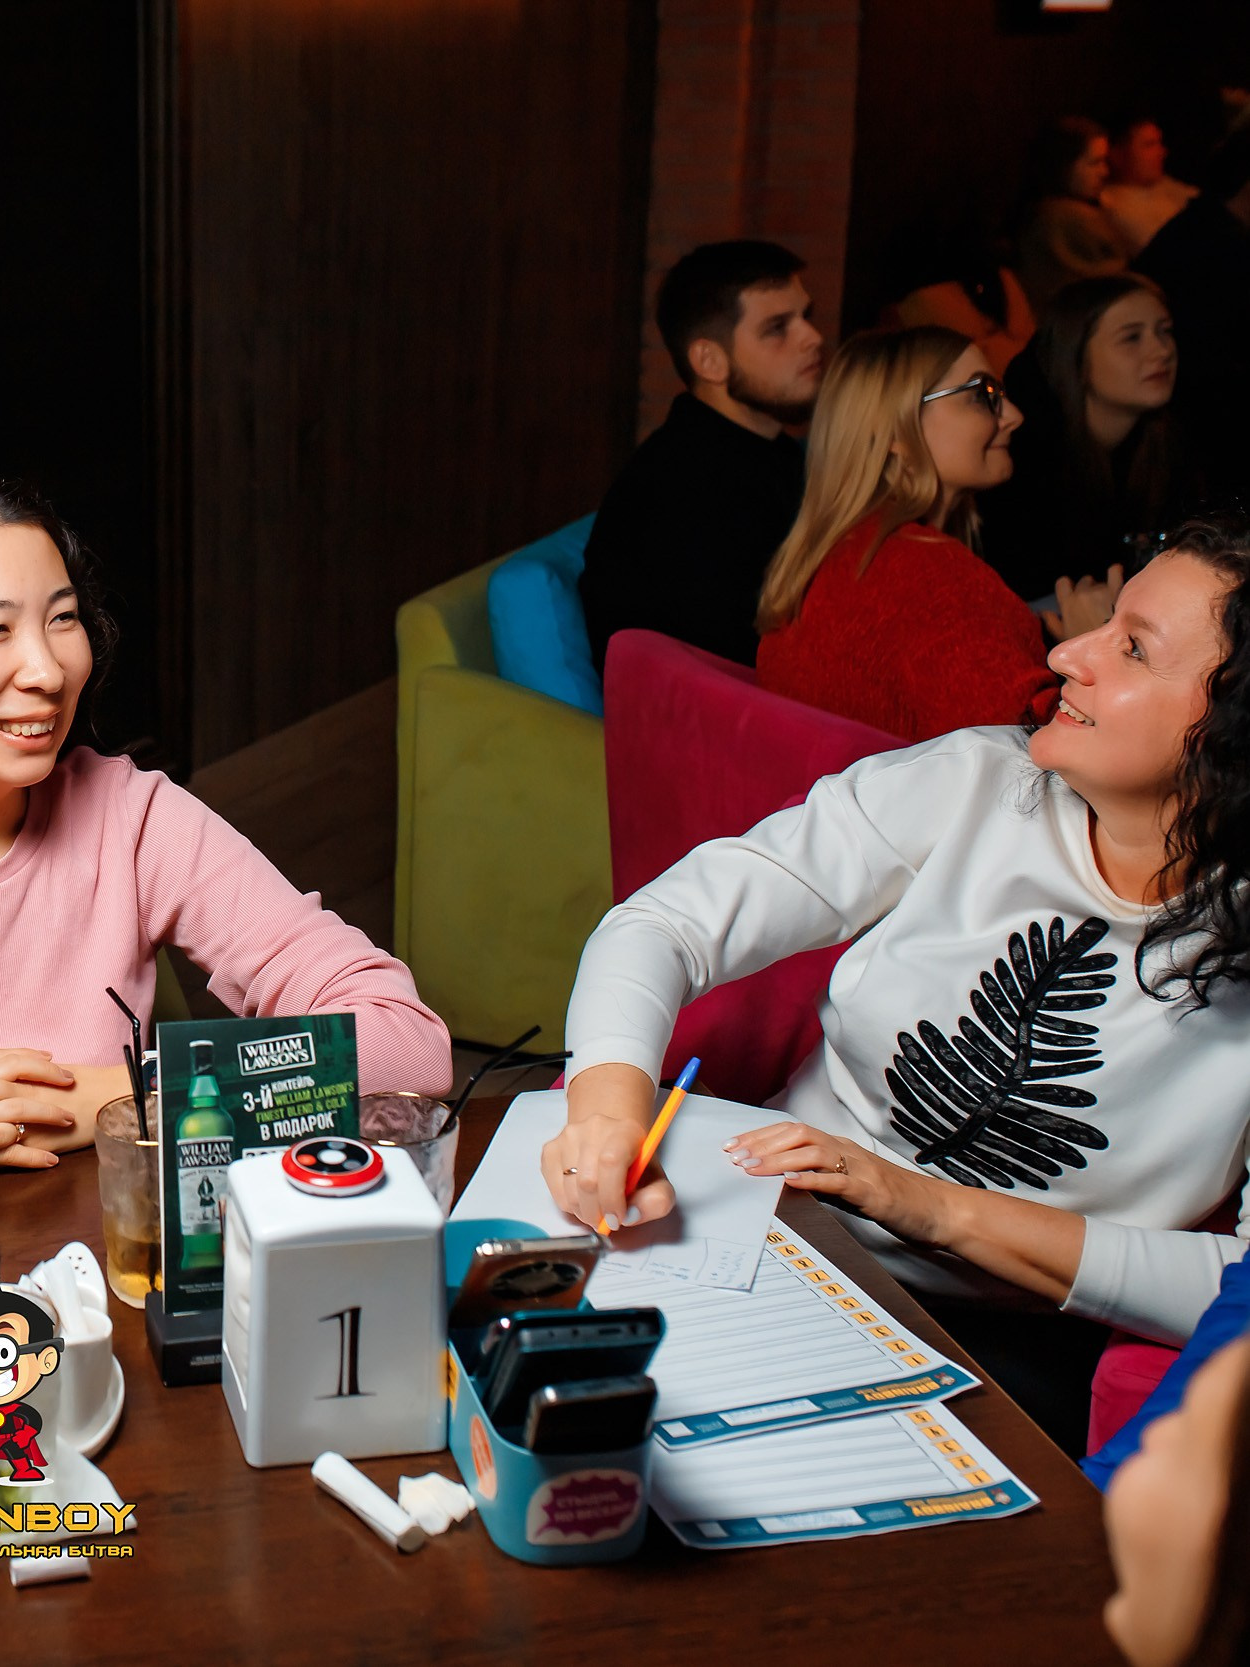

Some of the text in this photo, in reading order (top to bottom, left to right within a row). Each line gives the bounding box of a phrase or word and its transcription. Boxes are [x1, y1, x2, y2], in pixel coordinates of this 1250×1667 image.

[245, 1038, 303, 1058] WILLIAM
[244, 1049, 310, 1071] LAWSON'S
[271, 1075, 315, 1093] КОКТЕЙЛЬ
[274, 1082, 354, 1106] WILLIAM LAWSON'S
[256, 1107, 285, 1123] FINEST
[287, 1103, 314, 1117] BLEND
[325, 1097, 347, 1110] COLA
[260, 1124, 271, 1140] В
[314, 1305, 377, 1400] 1
